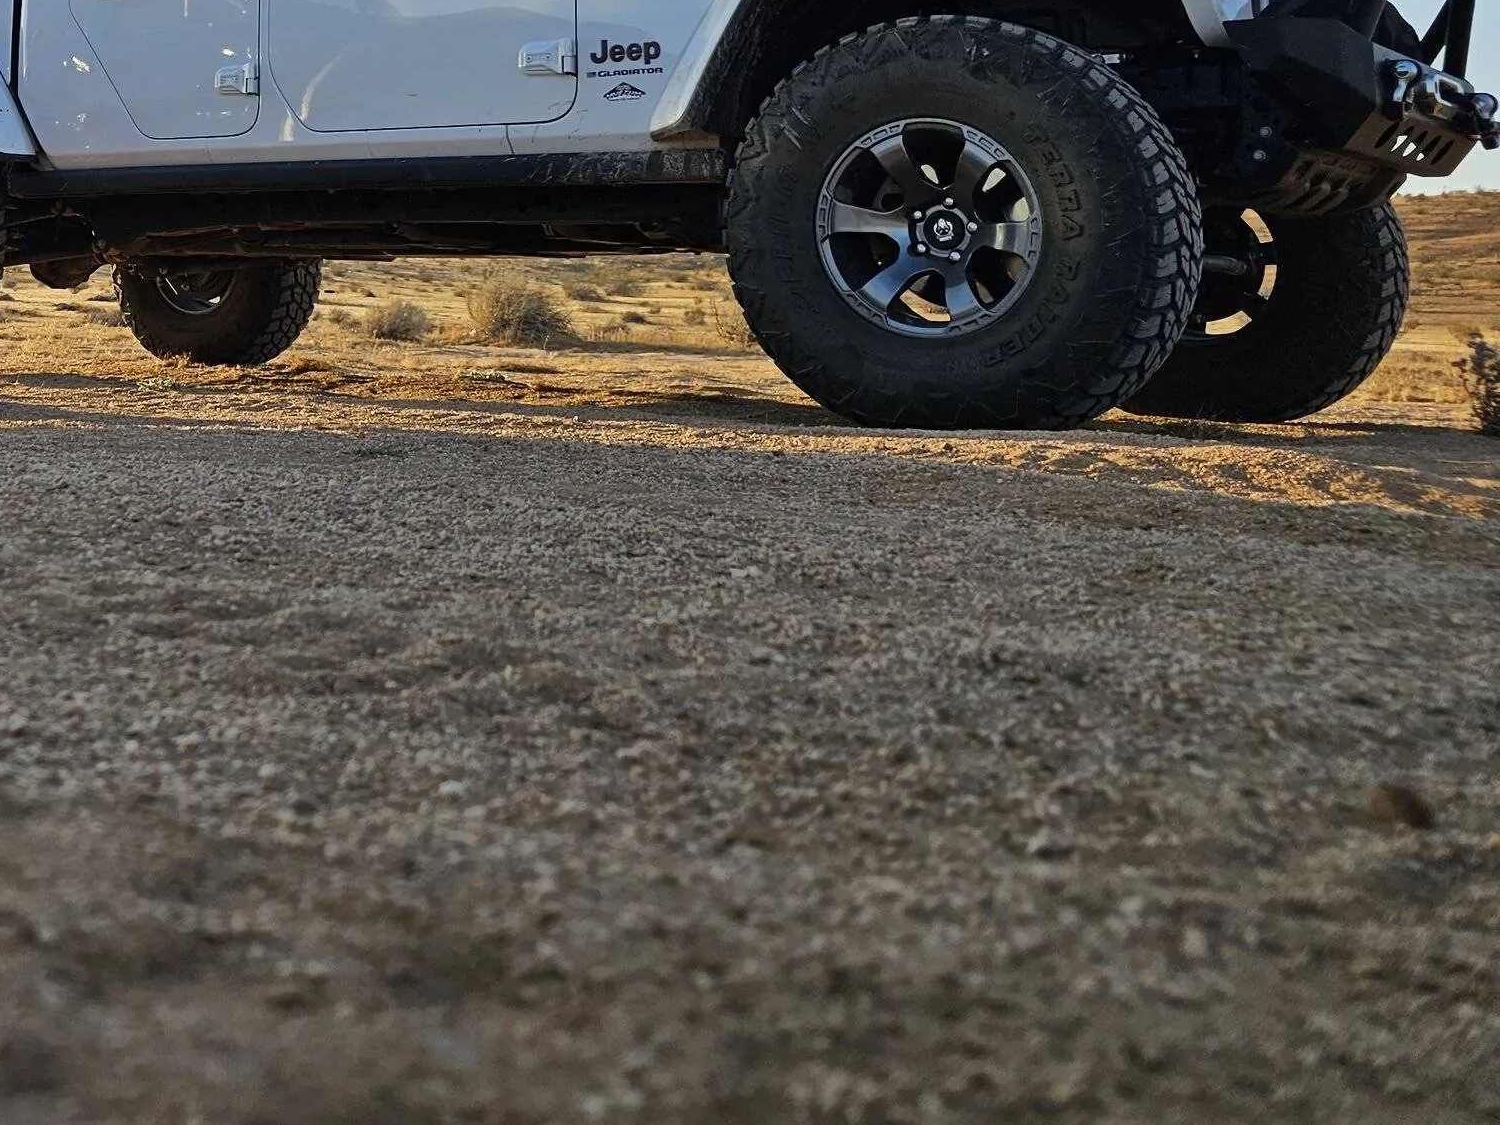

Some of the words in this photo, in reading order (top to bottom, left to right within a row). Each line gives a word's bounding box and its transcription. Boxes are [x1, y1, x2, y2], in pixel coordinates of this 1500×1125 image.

[589, 39, 661, 65] Jeep
[597, 67, 663, 77] GLADIATOR
[1020, 122, 1085, 241] TERRA
